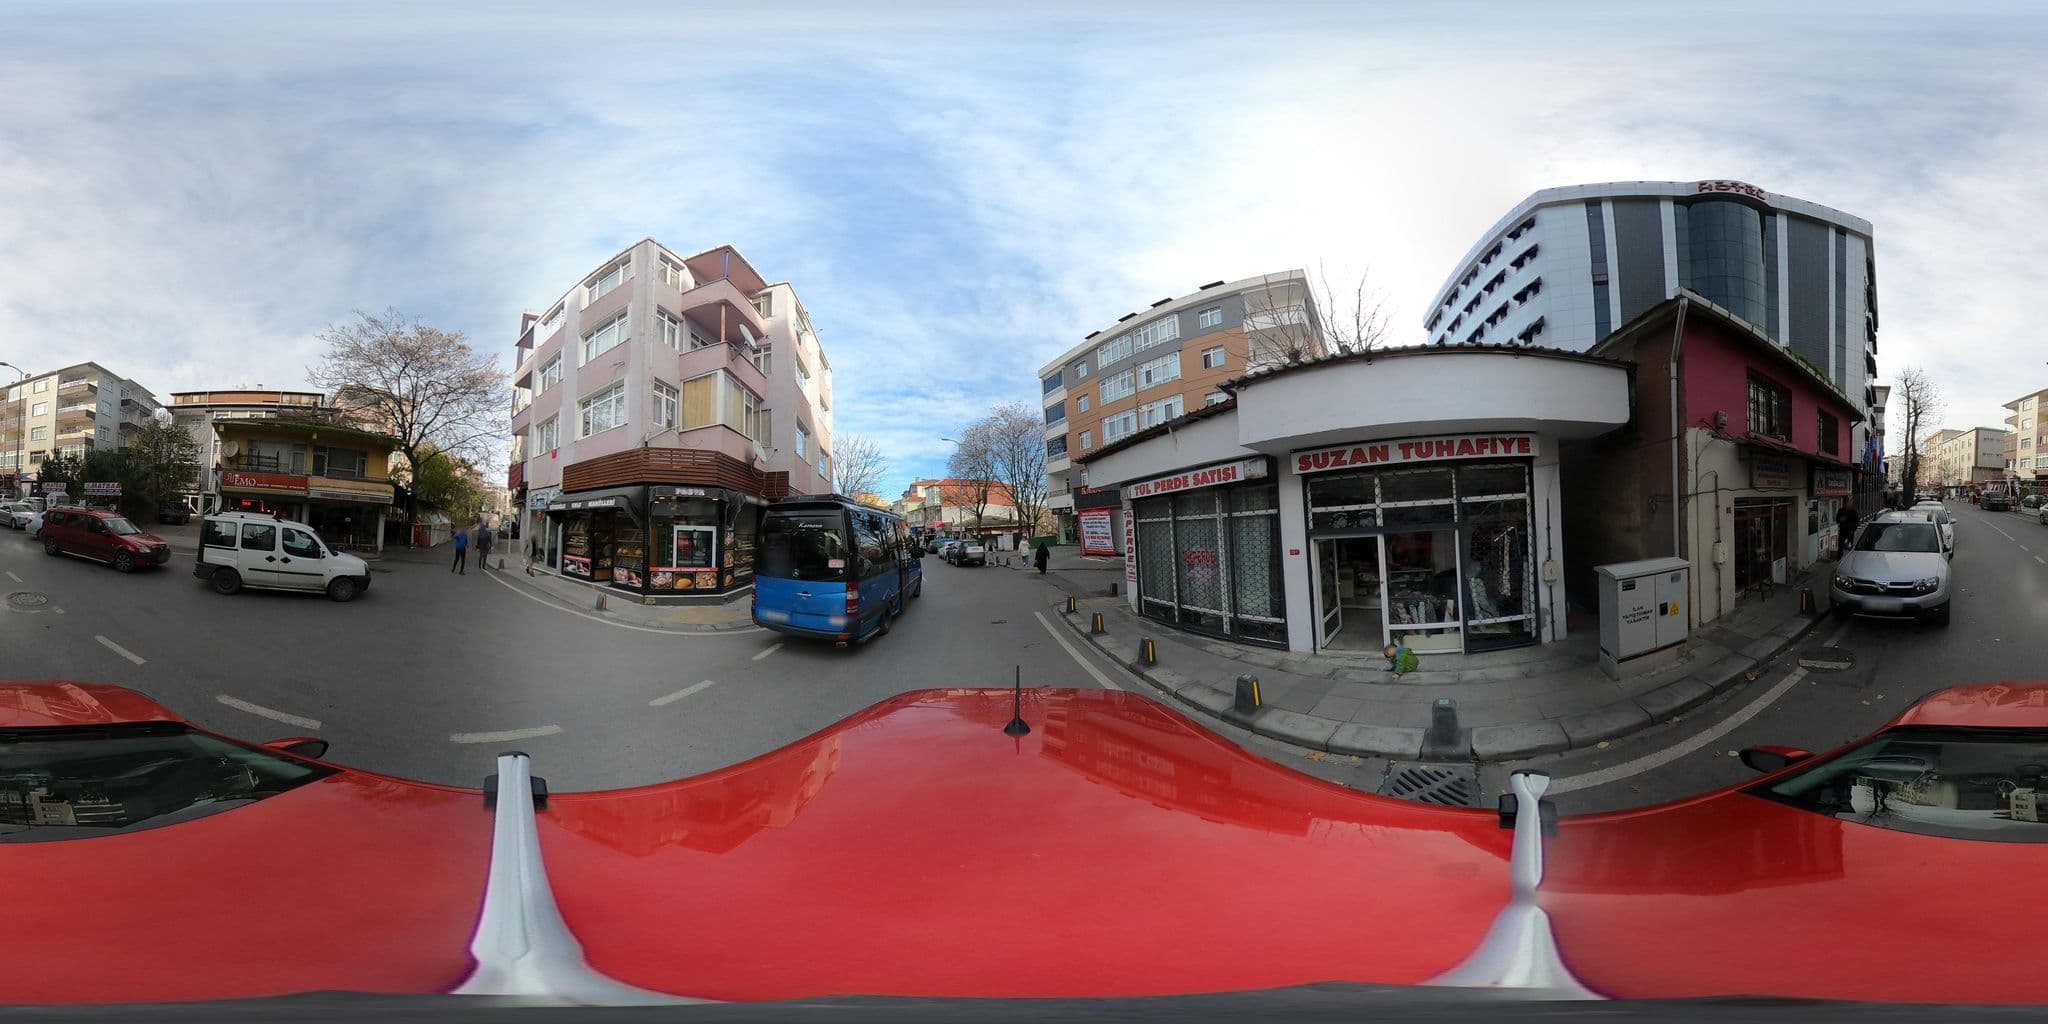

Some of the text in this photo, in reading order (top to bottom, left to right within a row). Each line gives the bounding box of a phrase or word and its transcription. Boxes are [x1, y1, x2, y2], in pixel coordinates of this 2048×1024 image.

[1698, 181, 1766, 200] HOTEL
[1298, 437, 1531, 471] SUZAN TUHAFİYE
[1153, 475, 1190, 493] PERDE
